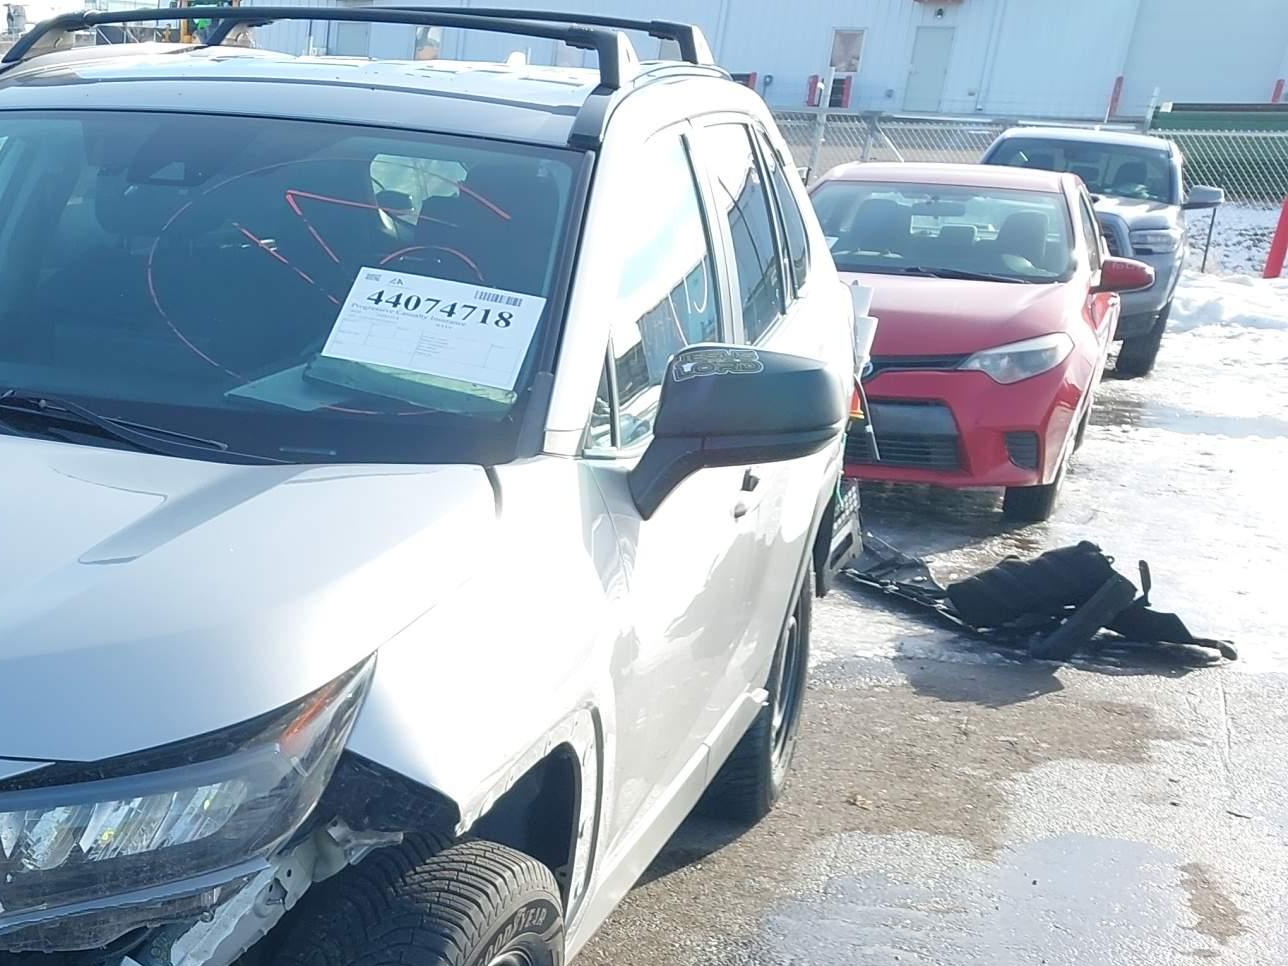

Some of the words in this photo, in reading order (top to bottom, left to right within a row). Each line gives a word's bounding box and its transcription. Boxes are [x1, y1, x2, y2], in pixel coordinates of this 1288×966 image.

[351, 303, 396, 315] Progressive
[396, 310, 427, 320] Casualty
[430, 315, 467, 327] Insurance
[367, 289, 514, 329] 44074718
